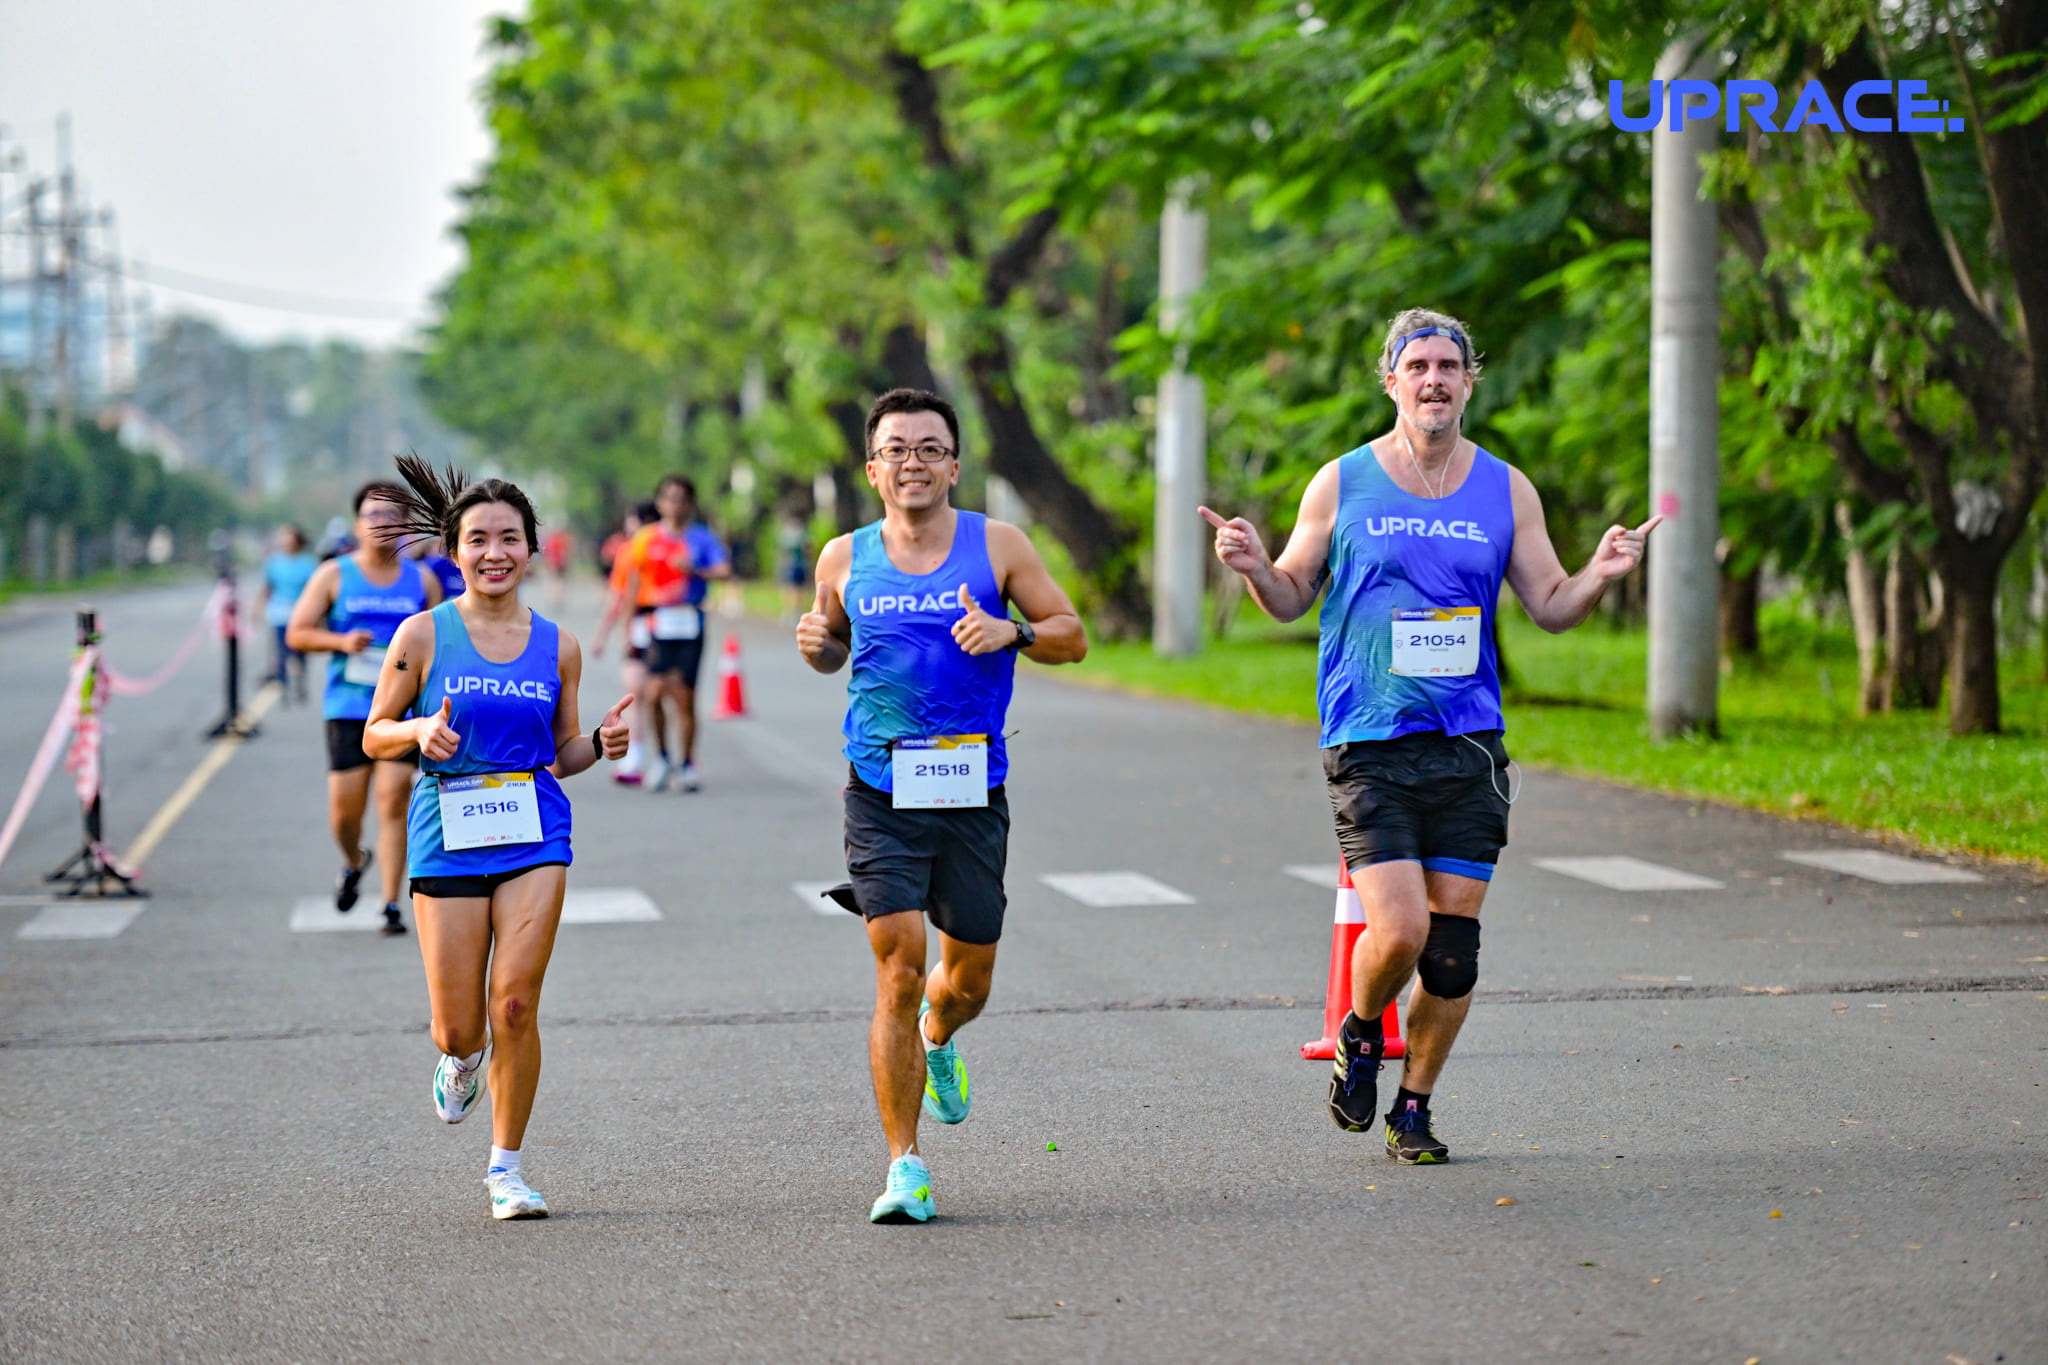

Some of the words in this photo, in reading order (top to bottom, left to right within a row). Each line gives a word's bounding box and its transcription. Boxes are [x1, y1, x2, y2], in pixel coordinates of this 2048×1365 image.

[1410, 634, 1466, 646] 21054
[915, 764, 970, 776] 21518
[462, 800, 519, 817] 21516
